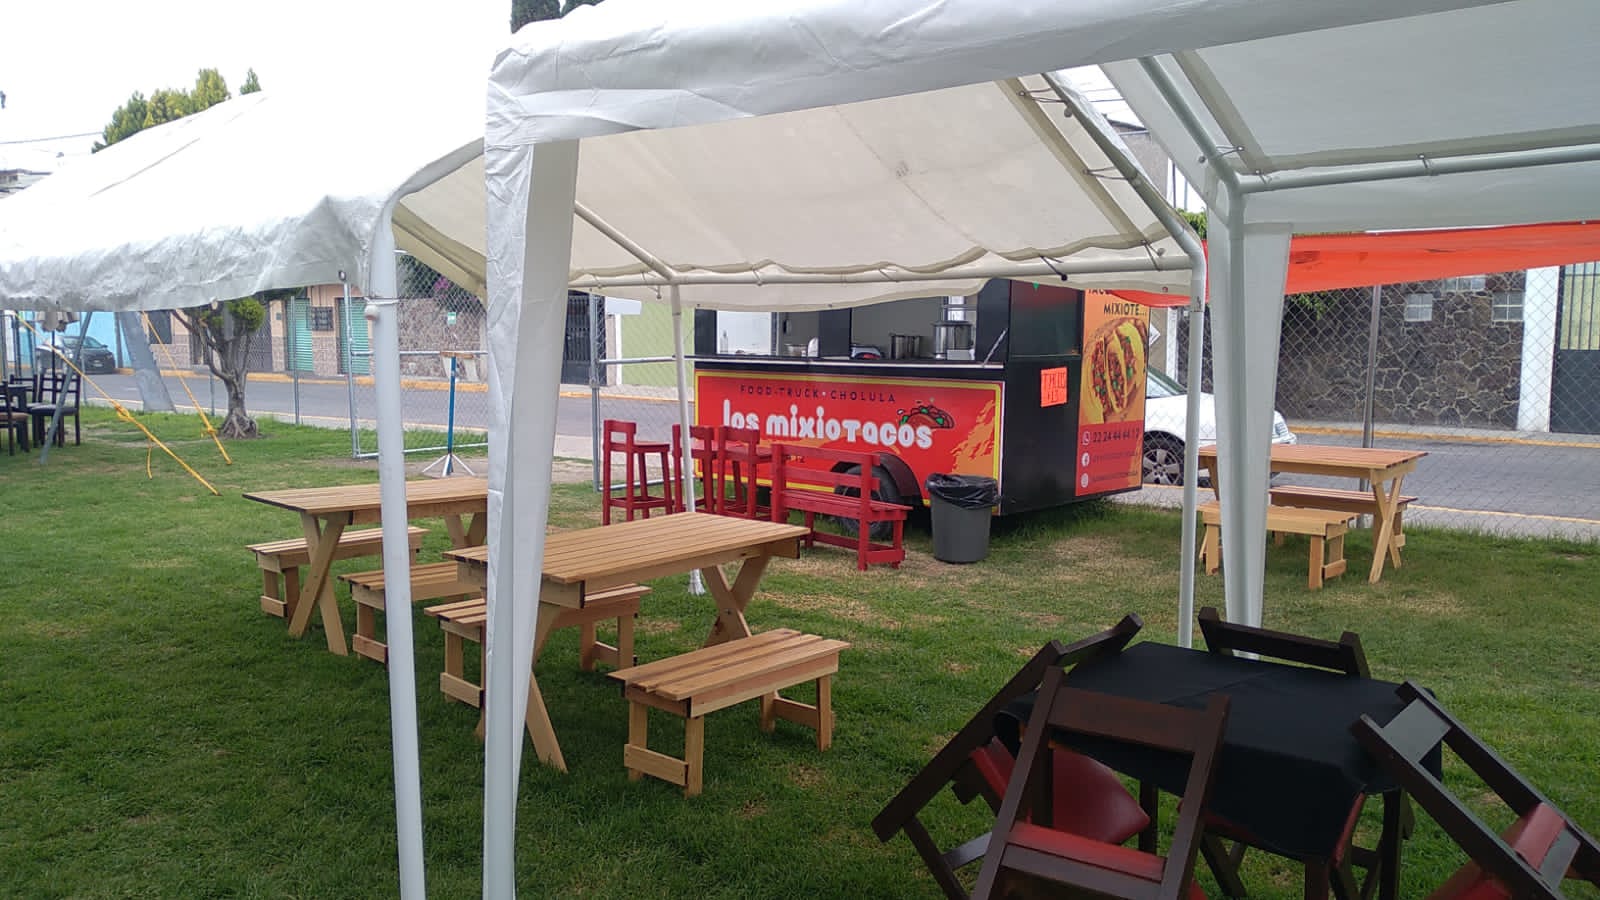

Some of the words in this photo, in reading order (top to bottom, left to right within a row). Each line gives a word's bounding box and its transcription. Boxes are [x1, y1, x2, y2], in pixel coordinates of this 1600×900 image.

[830, 390, 896, 403] CHOLULA
[1092, 431, 1102, 443] 22
[1103, 430, 1112, 442] 24
[1113, 431, 1121, 441] 44
